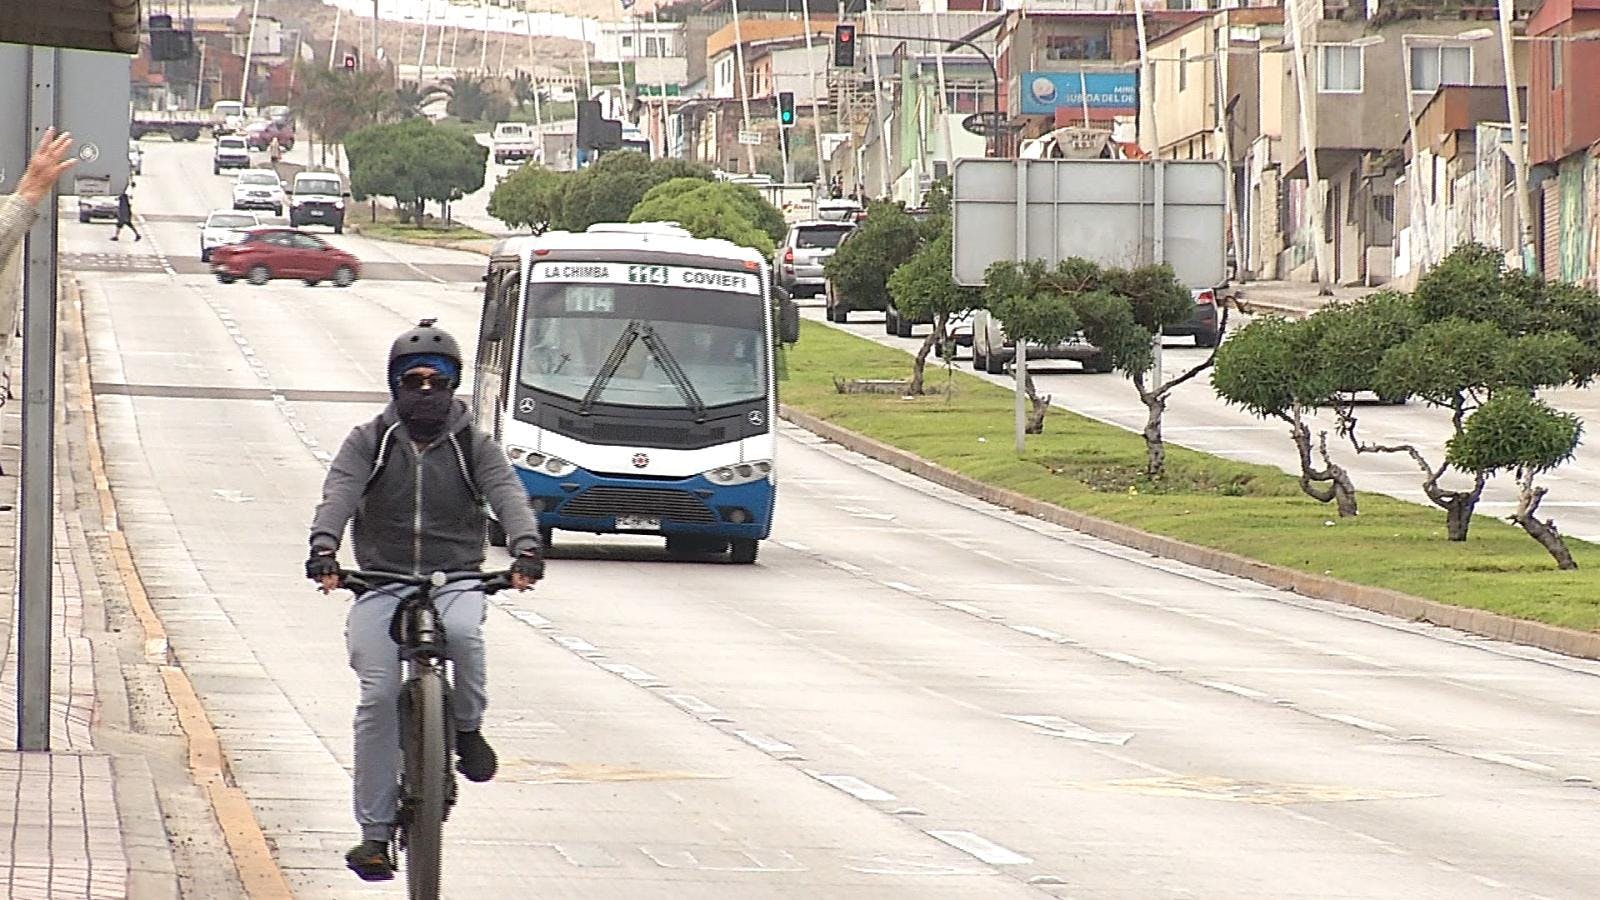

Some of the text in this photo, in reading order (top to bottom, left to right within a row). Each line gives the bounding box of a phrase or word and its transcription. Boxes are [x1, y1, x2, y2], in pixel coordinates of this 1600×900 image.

[544, 264, 748, 289] LA CHIMBA 114 COVIEFI
[573, 286, 609, 311] 114
